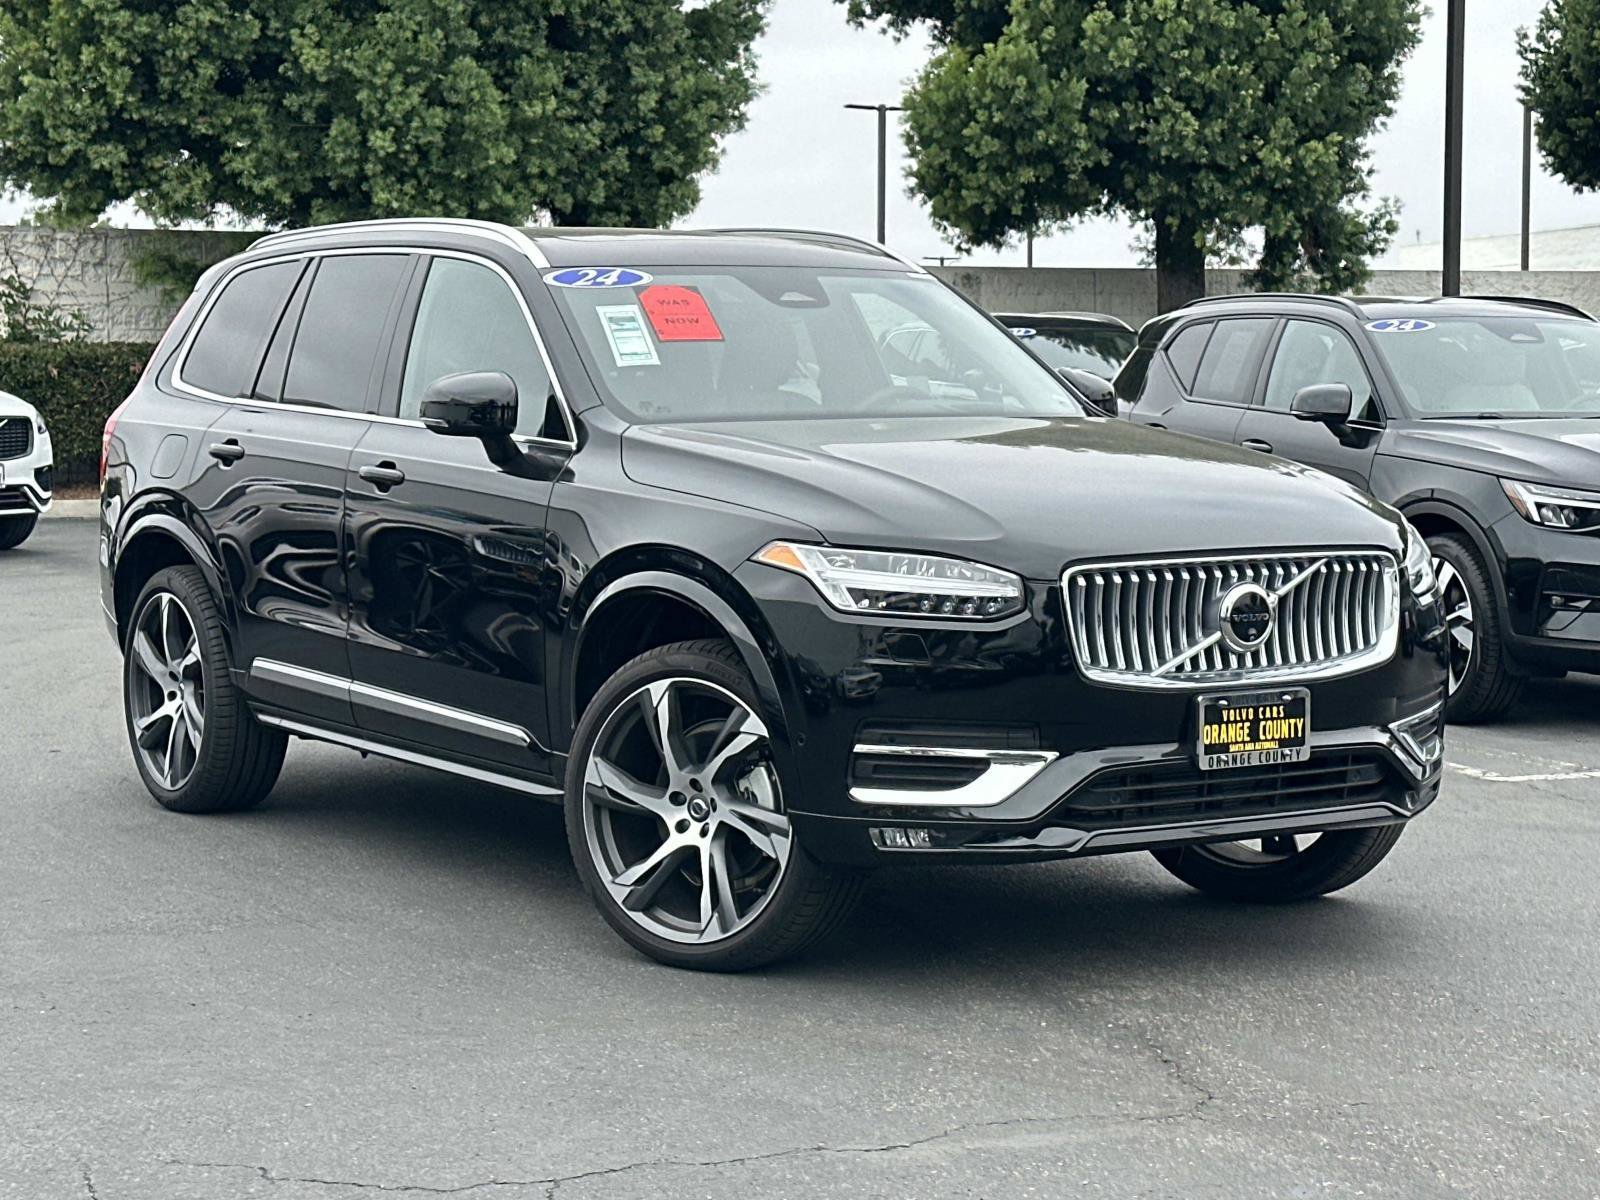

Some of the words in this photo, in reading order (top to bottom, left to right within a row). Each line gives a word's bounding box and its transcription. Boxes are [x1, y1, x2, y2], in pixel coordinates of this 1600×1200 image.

[573, 268, 620, 286] 24
[656, 298, 690, 306] WAS
[664, 317, 699, 325] NOW
[1384, 319, 1416, 332] 24
[1232, 612, 1269, 622] VOLVO
[1222, 708, 1254, 722] VOLVO
[1258, 706, 1284, 719] CARS
[1203, 722, 1251, 745] ORANGE
[1259, 718, 1304, 740] COUNTY
